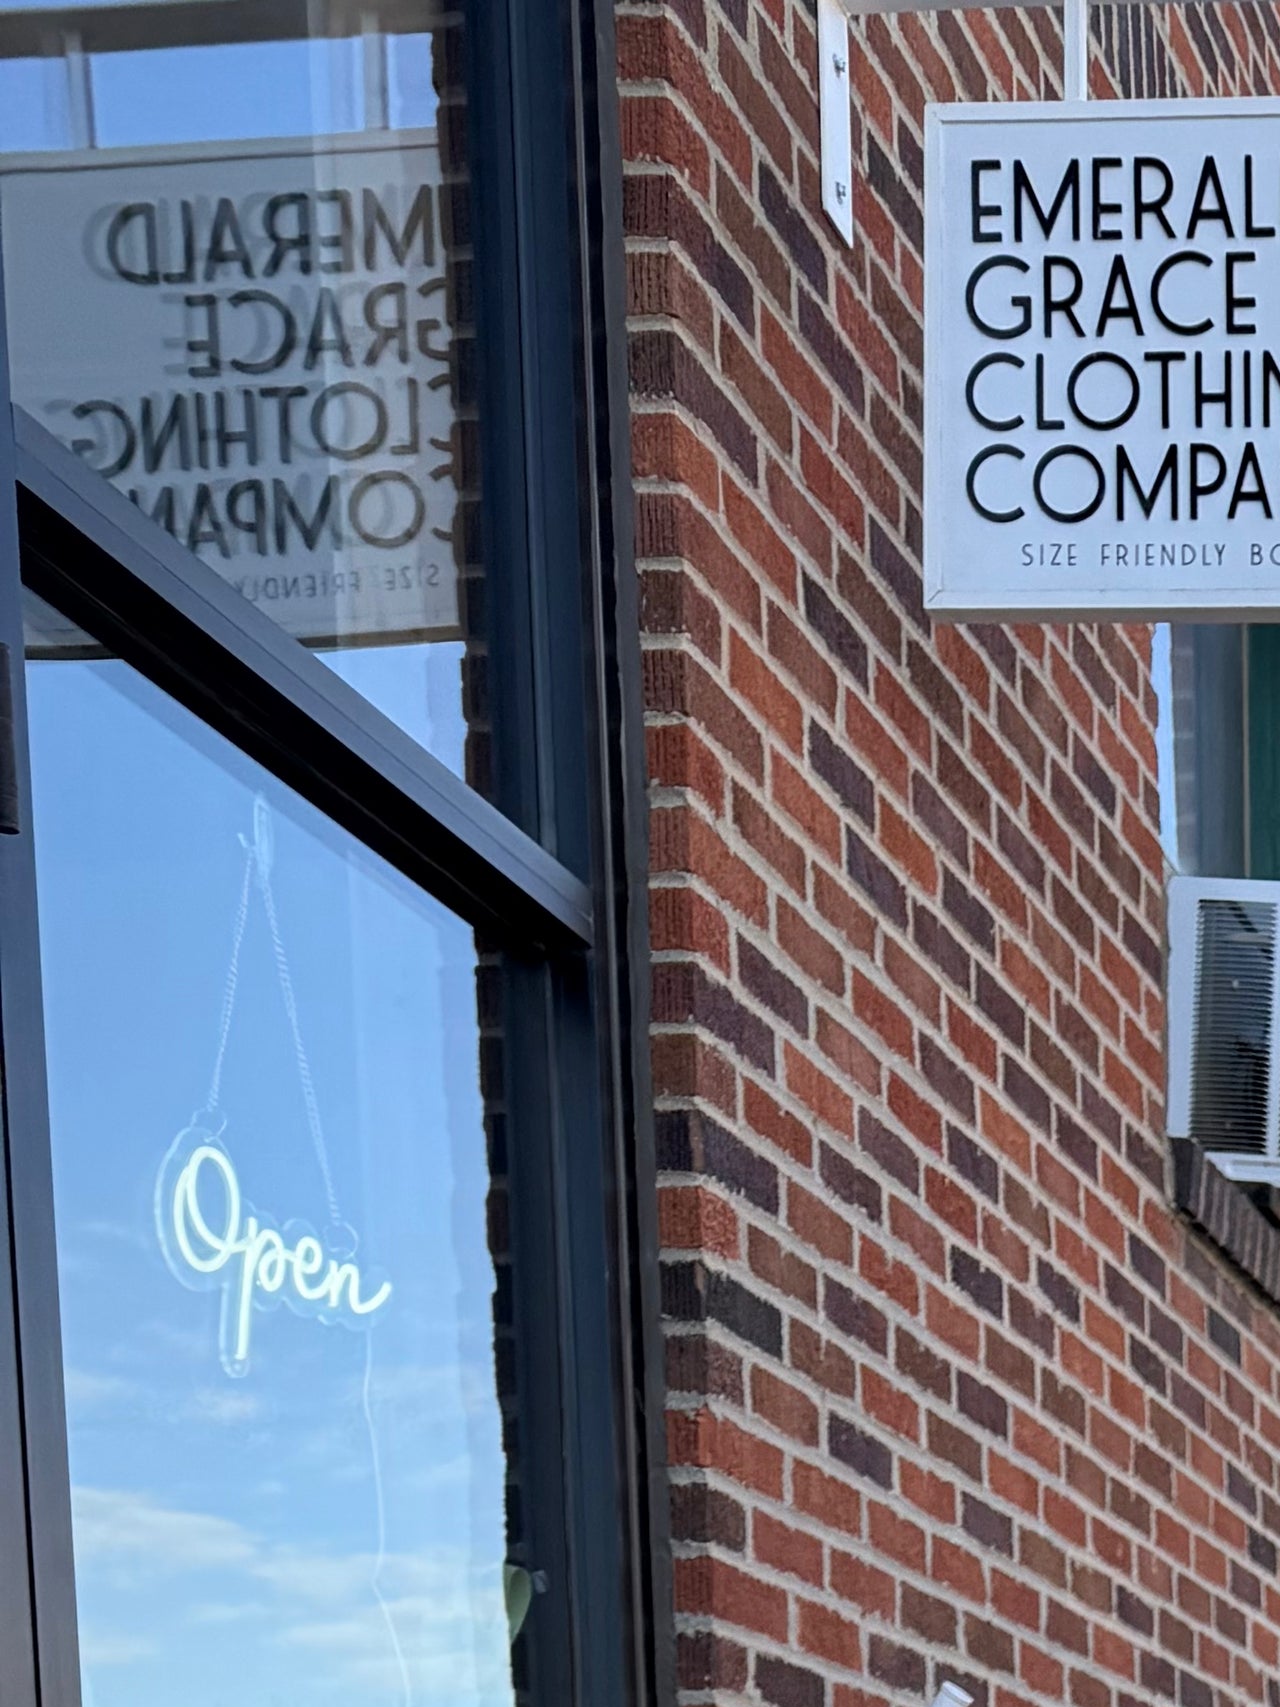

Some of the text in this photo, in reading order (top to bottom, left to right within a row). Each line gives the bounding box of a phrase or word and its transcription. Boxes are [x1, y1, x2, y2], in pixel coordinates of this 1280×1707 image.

[965, 250, 1257, 340] GRACE
[1021, 543, 1078, 567] SIZE
[1100, 543, 1227, 567] FRIENDLY
[173, 1146, 392, 1361] Open
